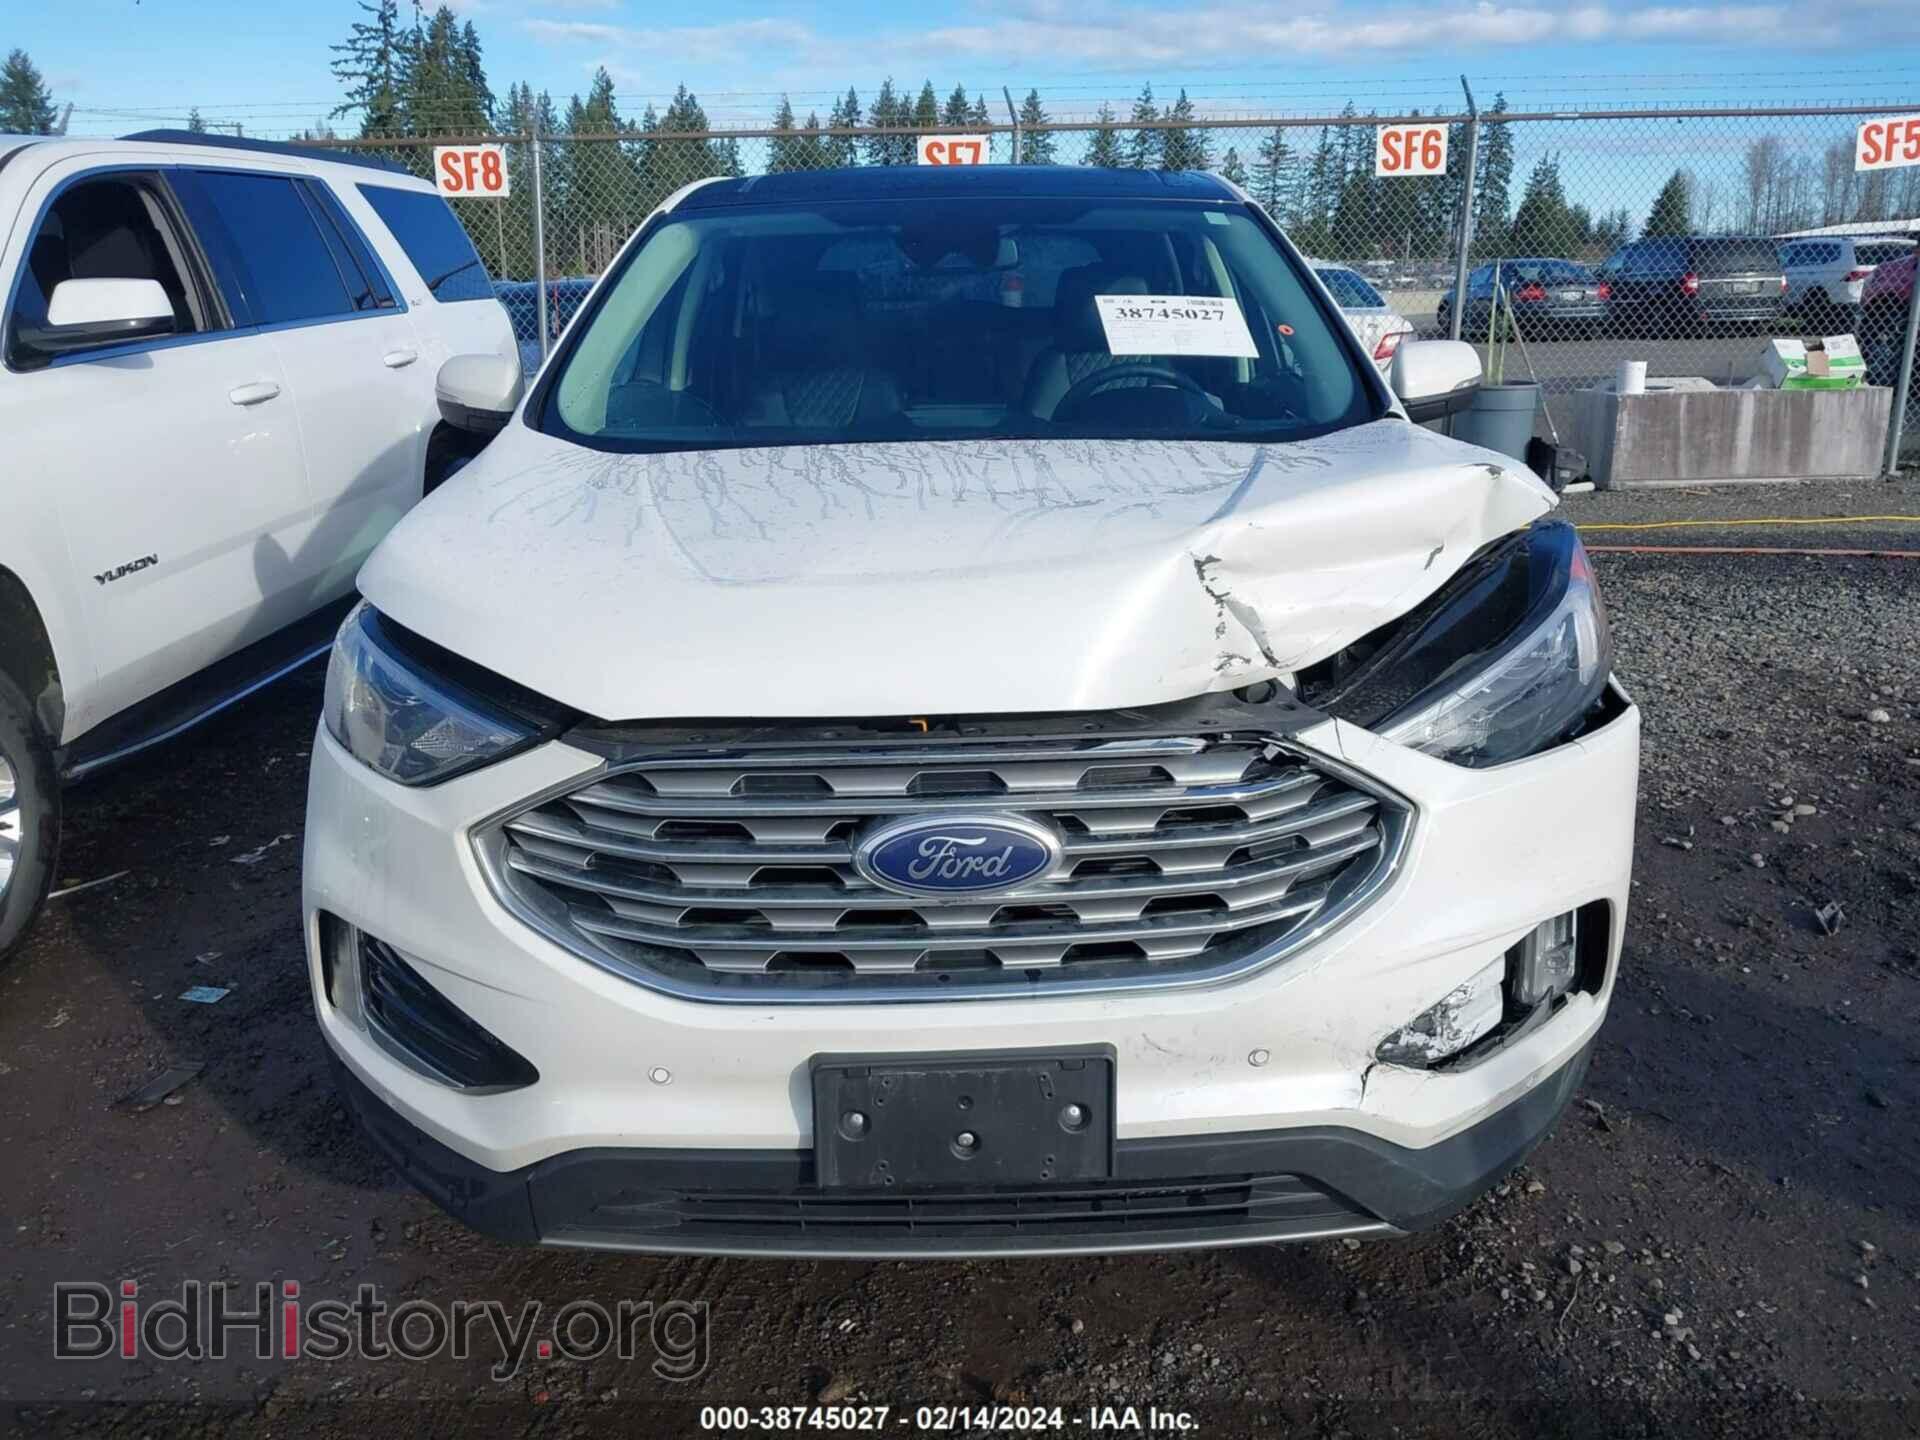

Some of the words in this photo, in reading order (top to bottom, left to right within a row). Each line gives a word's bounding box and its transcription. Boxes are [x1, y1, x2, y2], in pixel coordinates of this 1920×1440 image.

[1381, 129, 1442, 171] SF6
[1862, 120, 1920, 164] SF5
[440, 151, 503, 192] SF8
[1115, 307, 1224, 321] 38745027
[93, 553, 159, 585] YUKON
[907, 836, 1014, 879] Ford
